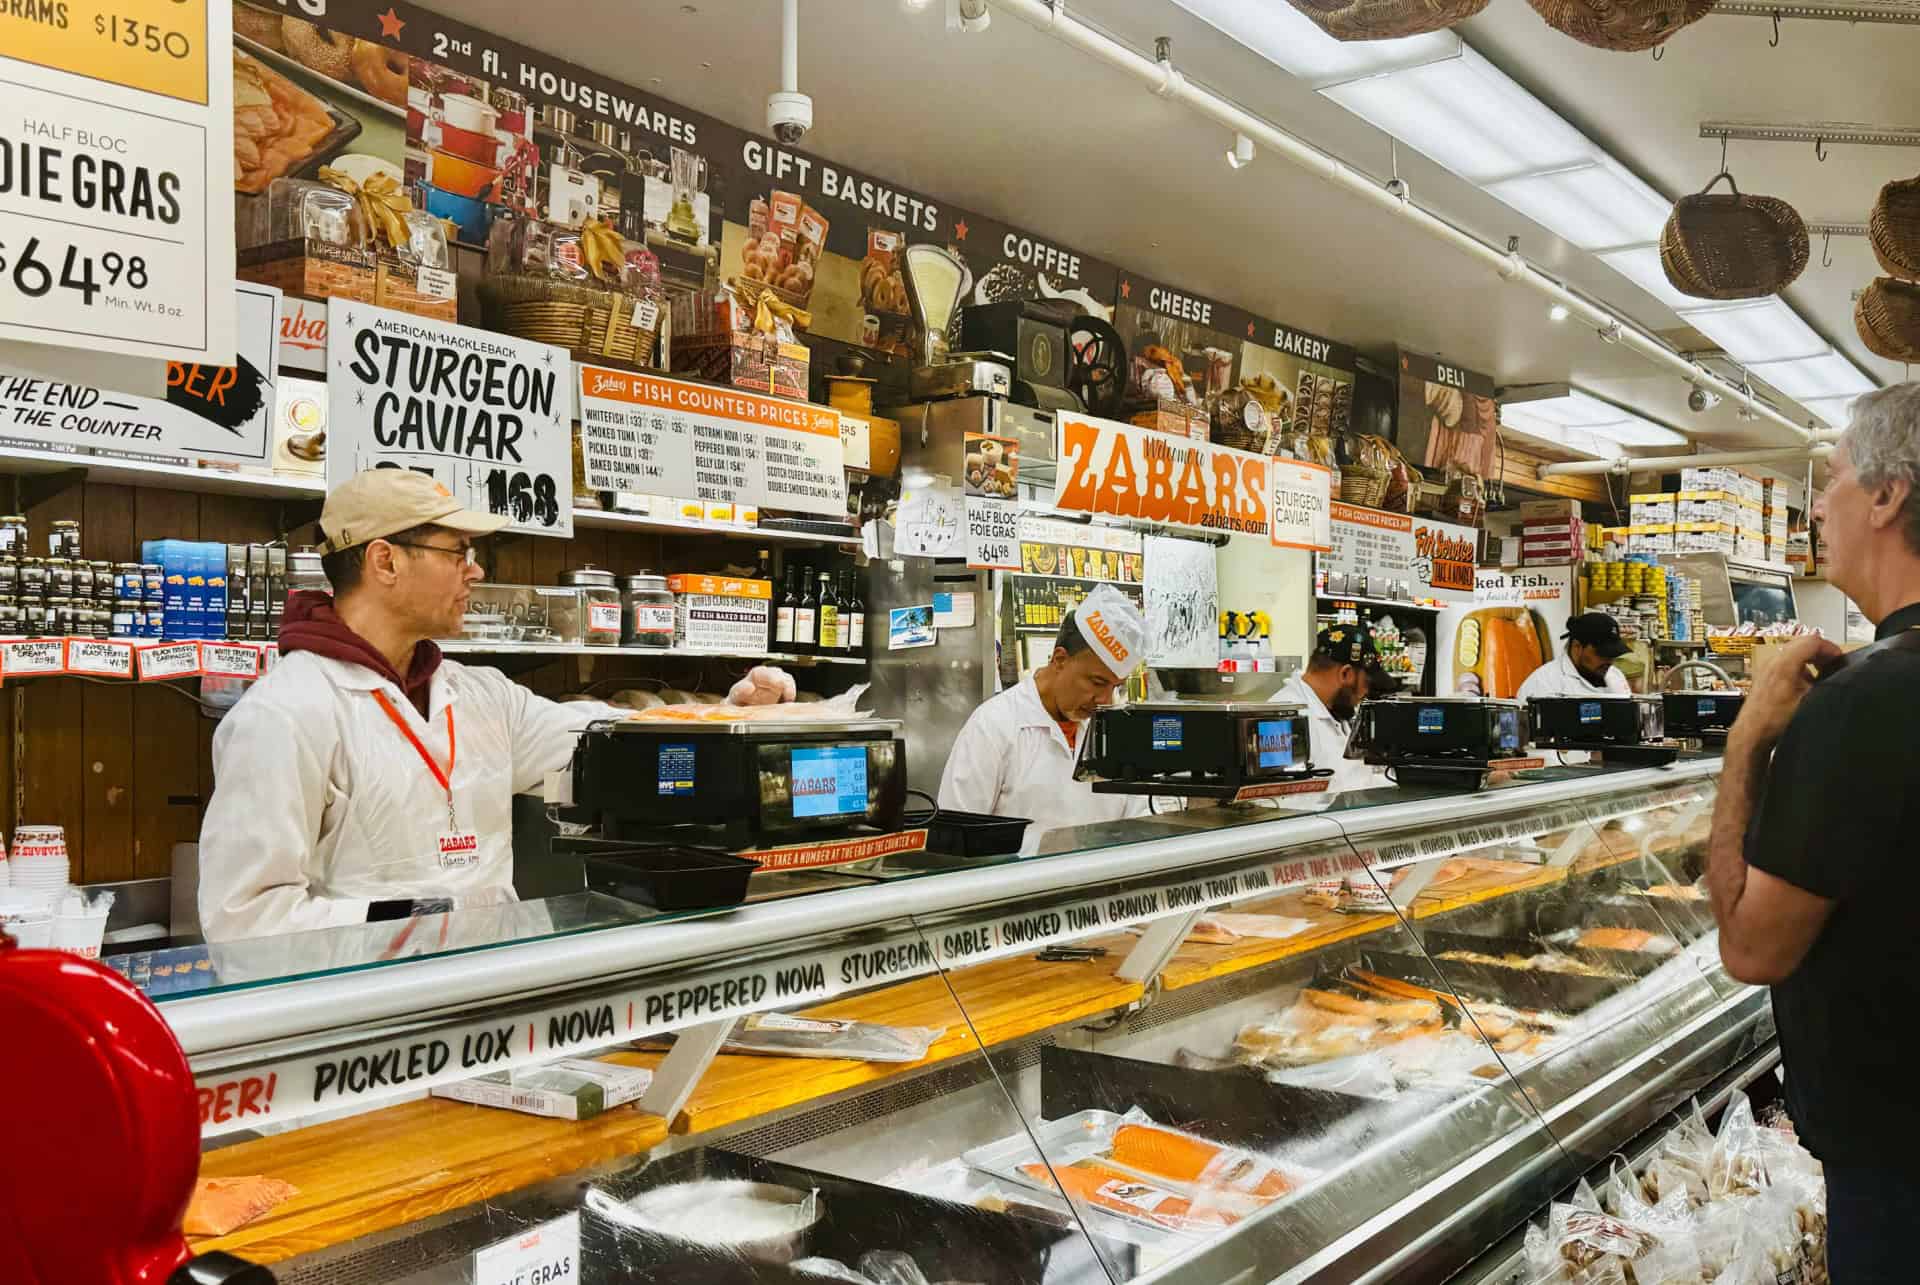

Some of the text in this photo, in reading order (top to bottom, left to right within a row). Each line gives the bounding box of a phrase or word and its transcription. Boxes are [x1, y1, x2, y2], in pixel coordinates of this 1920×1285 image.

[94, 13, 190, 59] $1350
[432, 32, 697, 146] 2nd fl. HOUSEWARES
[24, 118, 127, 154] HALF BLOC
[72, 153, 180, 225] GRAS
[742, 139, 939, 233] GIFT BASKETS
[1003, 233, 1081, 282] COFFEE
[158, 303, 165, 314] 8
[1149, 287, 1212, 325] CHEESE
[374, 318, 437, 343] AMERICAN
[1274, 327, 1331, 363] BAKERY
[349, 328, 556, 417] STURGEON
[1437, 363, 1465, 388] DELI
[44, 382, 100, 410] END
[633, 381, 672, 403] FISH
[678, 390, 756, 417] COUNTER
[760, 404, 809, 427] PRICES
[13, 407, 163, 441] THE COUNTER
[373, 391, 523, 463] CAVIAR
[585, 408, 625, 425] WHITEFISH
[586, 424, 615, 440] SMOKED
[588, 441, 617, 456] PICKLED
[1275, 488, 1322, 512] STURGEON
[968, 509, 1016, 526] HALF BLOC
[970, 523, 991, 537] FOIE
[992, 524, 1016, 539] GRAS
[1201, 510, 1269, 536] zabars.com
[1275, 507, 1311, 528] CAVIAR
[800, 850, 830, 864] NUMBER
[313, 1038, 450, 1102] PICKLED
[461, 1023, 515, 1070] LOX
[547, 1003, 616, 1049] NOVA
[645, 973, 767, 1026] PEPPERED
[775, 961, 826, 1004] NOVA
[840, 940, 932, 984] STURGEON
[943, 924, 992, 960] SABLE
[1002, 911, 1061, 946] SMOKED
[1065, 902, 1101, 931] TUNA
[1109, 891, 1158, 923] GRAVLOX
[1167, 883, 1205, 910] BROOK
[1206, 875, 1240, 901] TROUT
